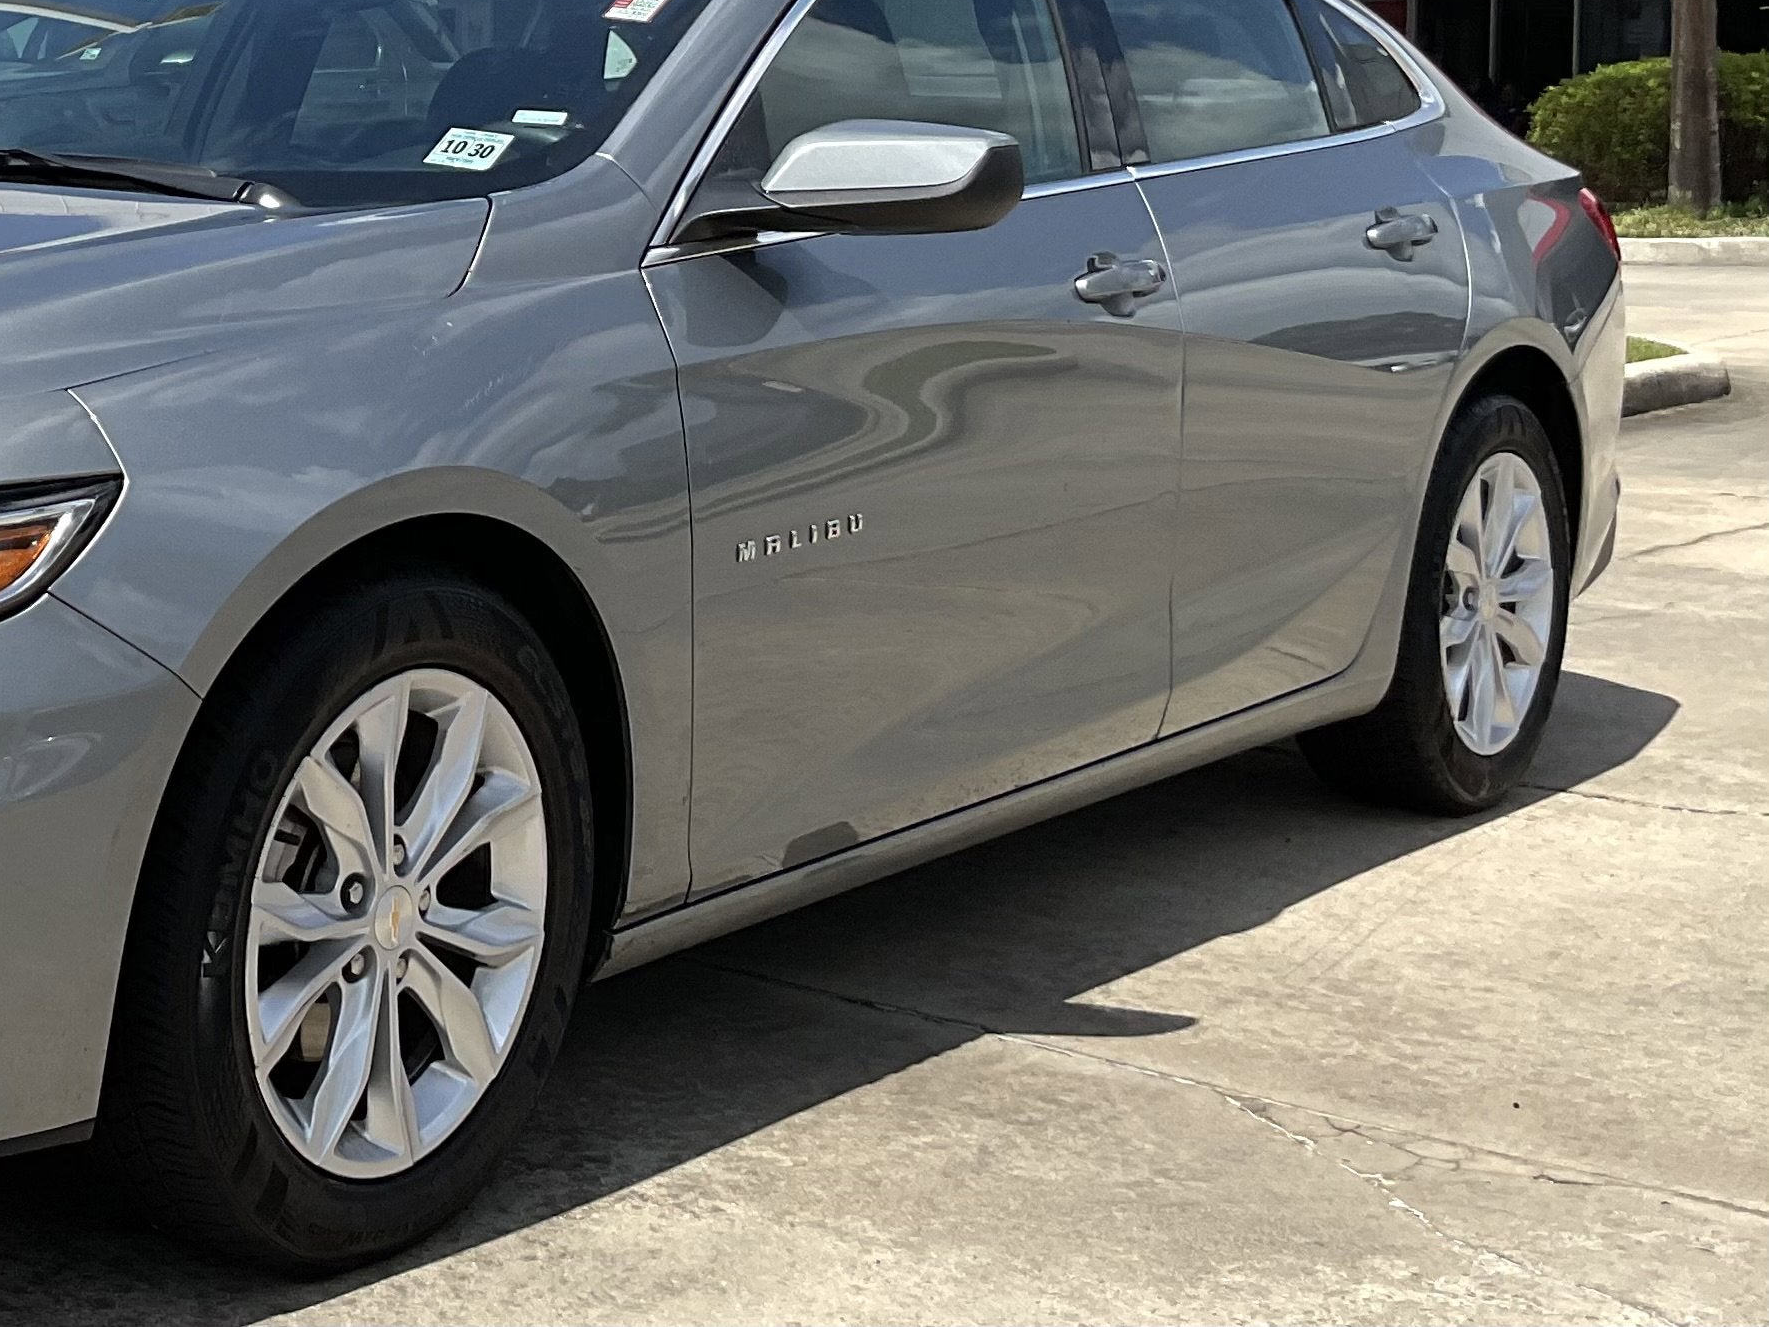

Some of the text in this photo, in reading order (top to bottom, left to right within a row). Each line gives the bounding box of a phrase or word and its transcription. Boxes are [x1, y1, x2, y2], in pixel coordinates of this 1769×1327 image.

[440, 139, 495, 159] 10 30
[736, 513, 863, 563] MALIBU
